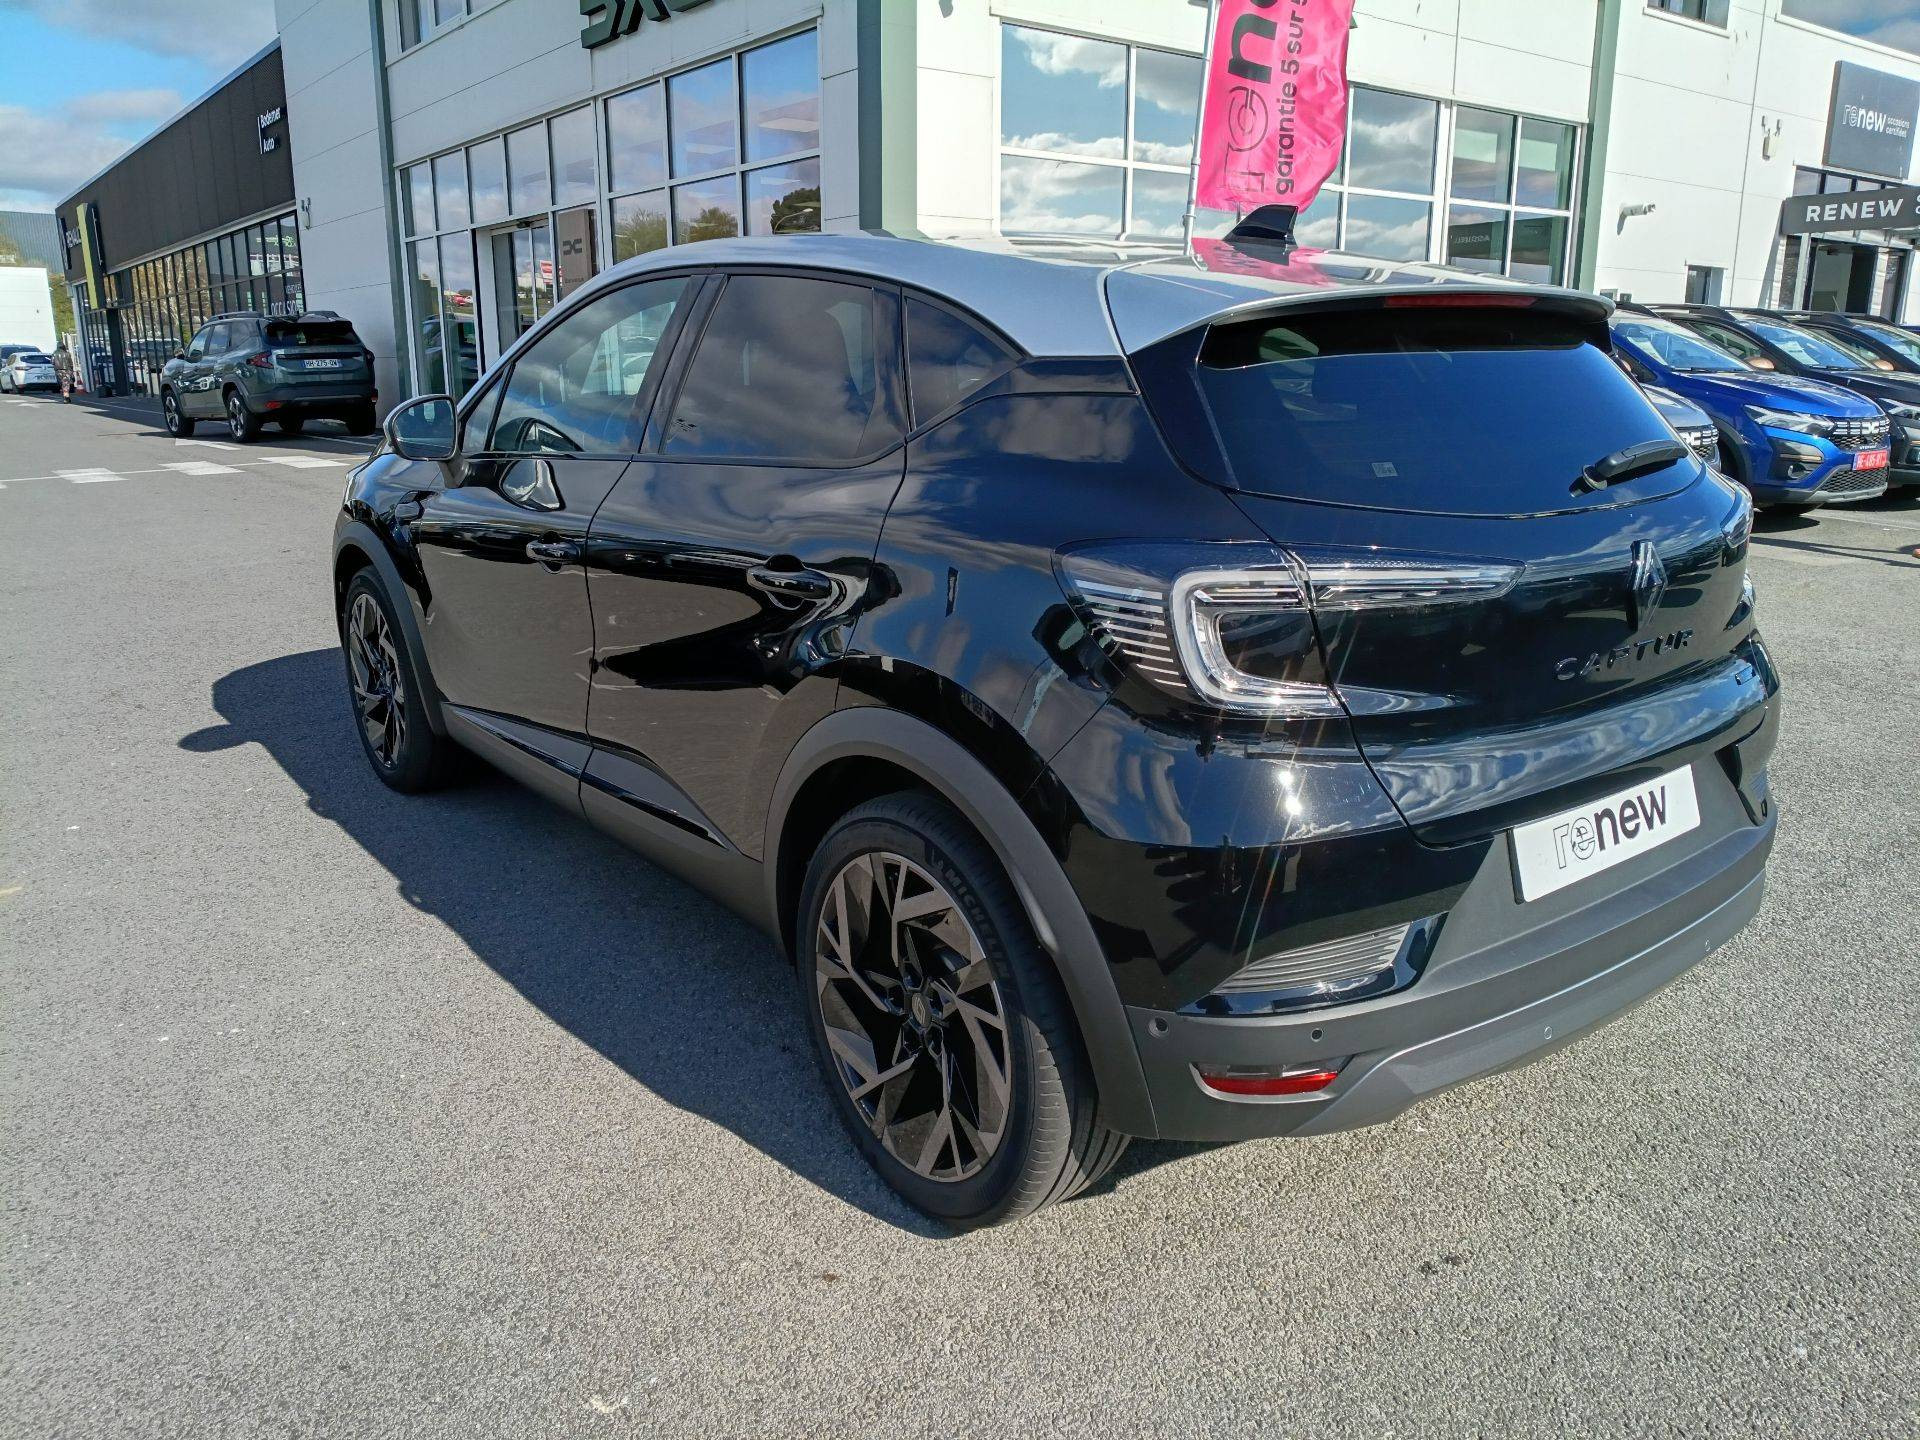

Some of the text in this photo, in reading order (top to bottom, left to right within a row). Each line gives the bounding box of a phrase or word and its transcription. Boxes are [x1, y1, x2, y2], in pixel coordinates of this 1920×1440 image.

[1287, 10, 1305, 55] sur
[1281, 58, 1299, 77] 5
[1276, 81, 1298, 196] garantie
[1842, 104, 1887, 133] renew
[1805, 198, 1904, 222] RENEW
[1553, 628, 1694, 681] CAPTUR
[1552, 784, 1667, 870] renew
